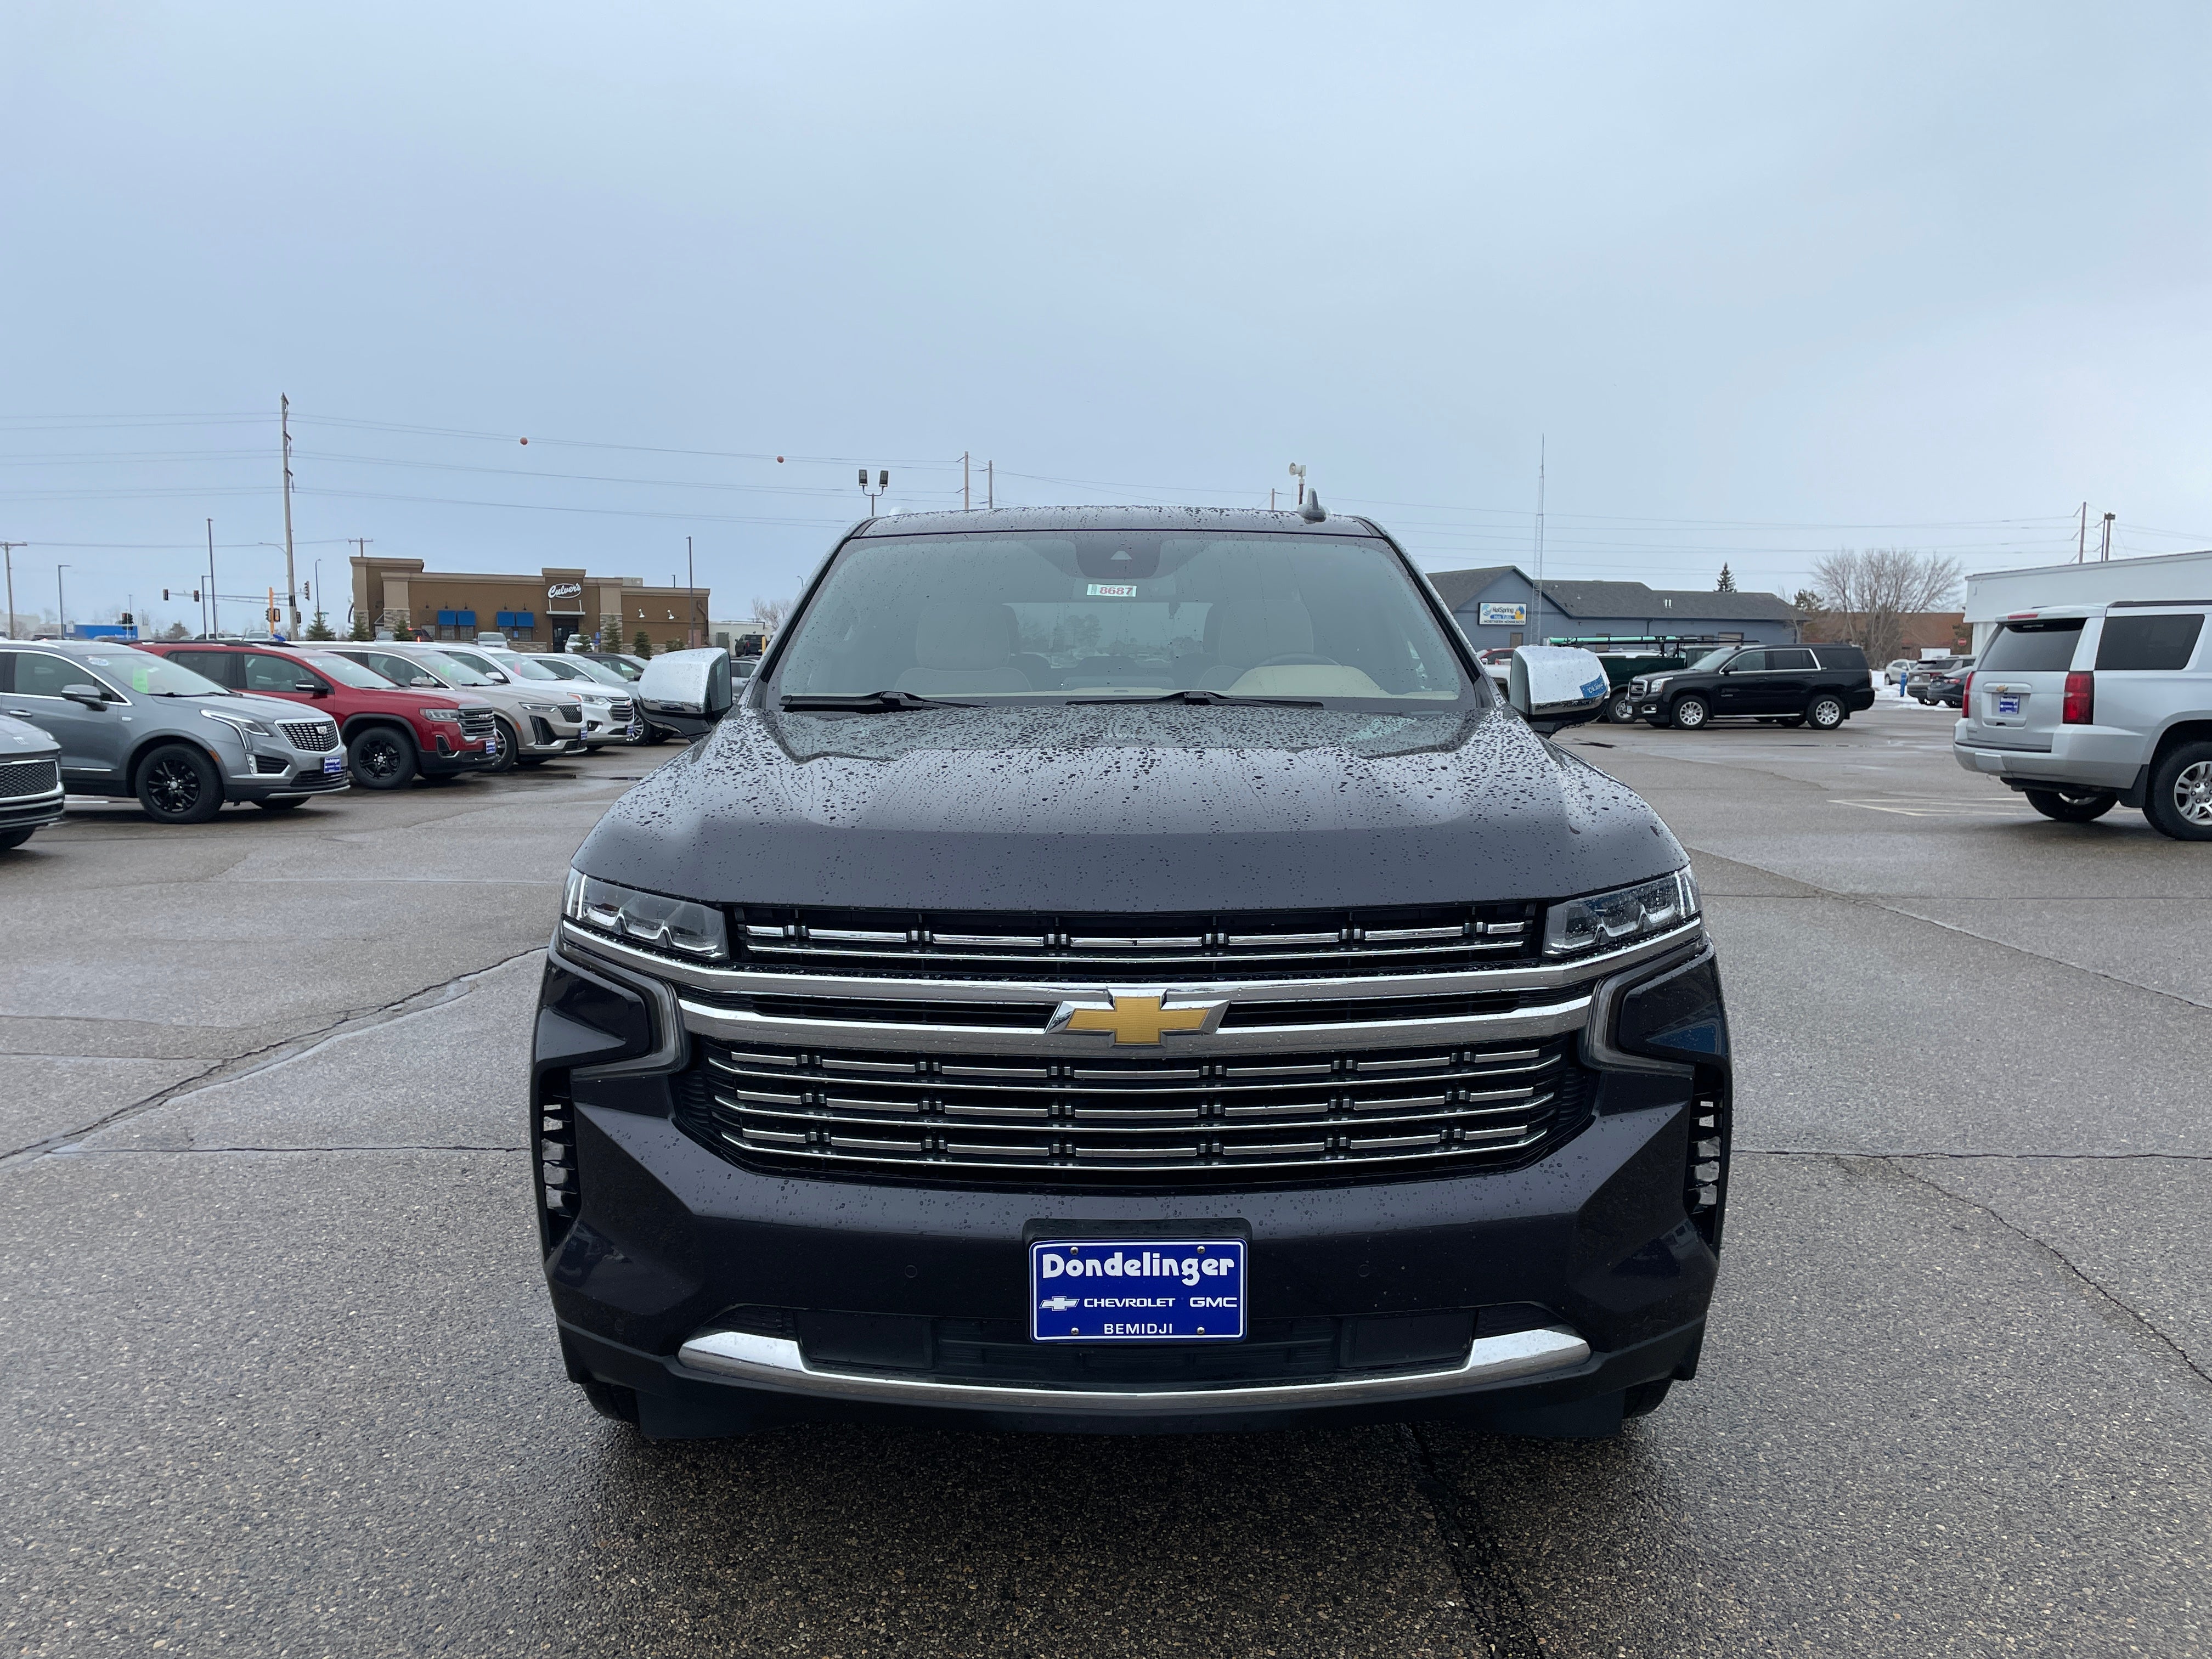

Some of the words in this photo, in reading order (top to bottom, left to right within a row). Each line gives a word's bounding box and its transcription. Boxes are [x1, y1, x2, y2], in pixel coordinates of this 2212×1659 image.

[548, 583, 582, 599] Culver's
[1099, 586, 1133, 595] 8687
[1042, 1251, 1234, 1286] Dondelinger
[1084, 1298, 1176, 1307] CHEVROLET
[1189, 1297, 1238, 1307] GMC
[1104, 1323, 1173, 1335] BEMIDJI
